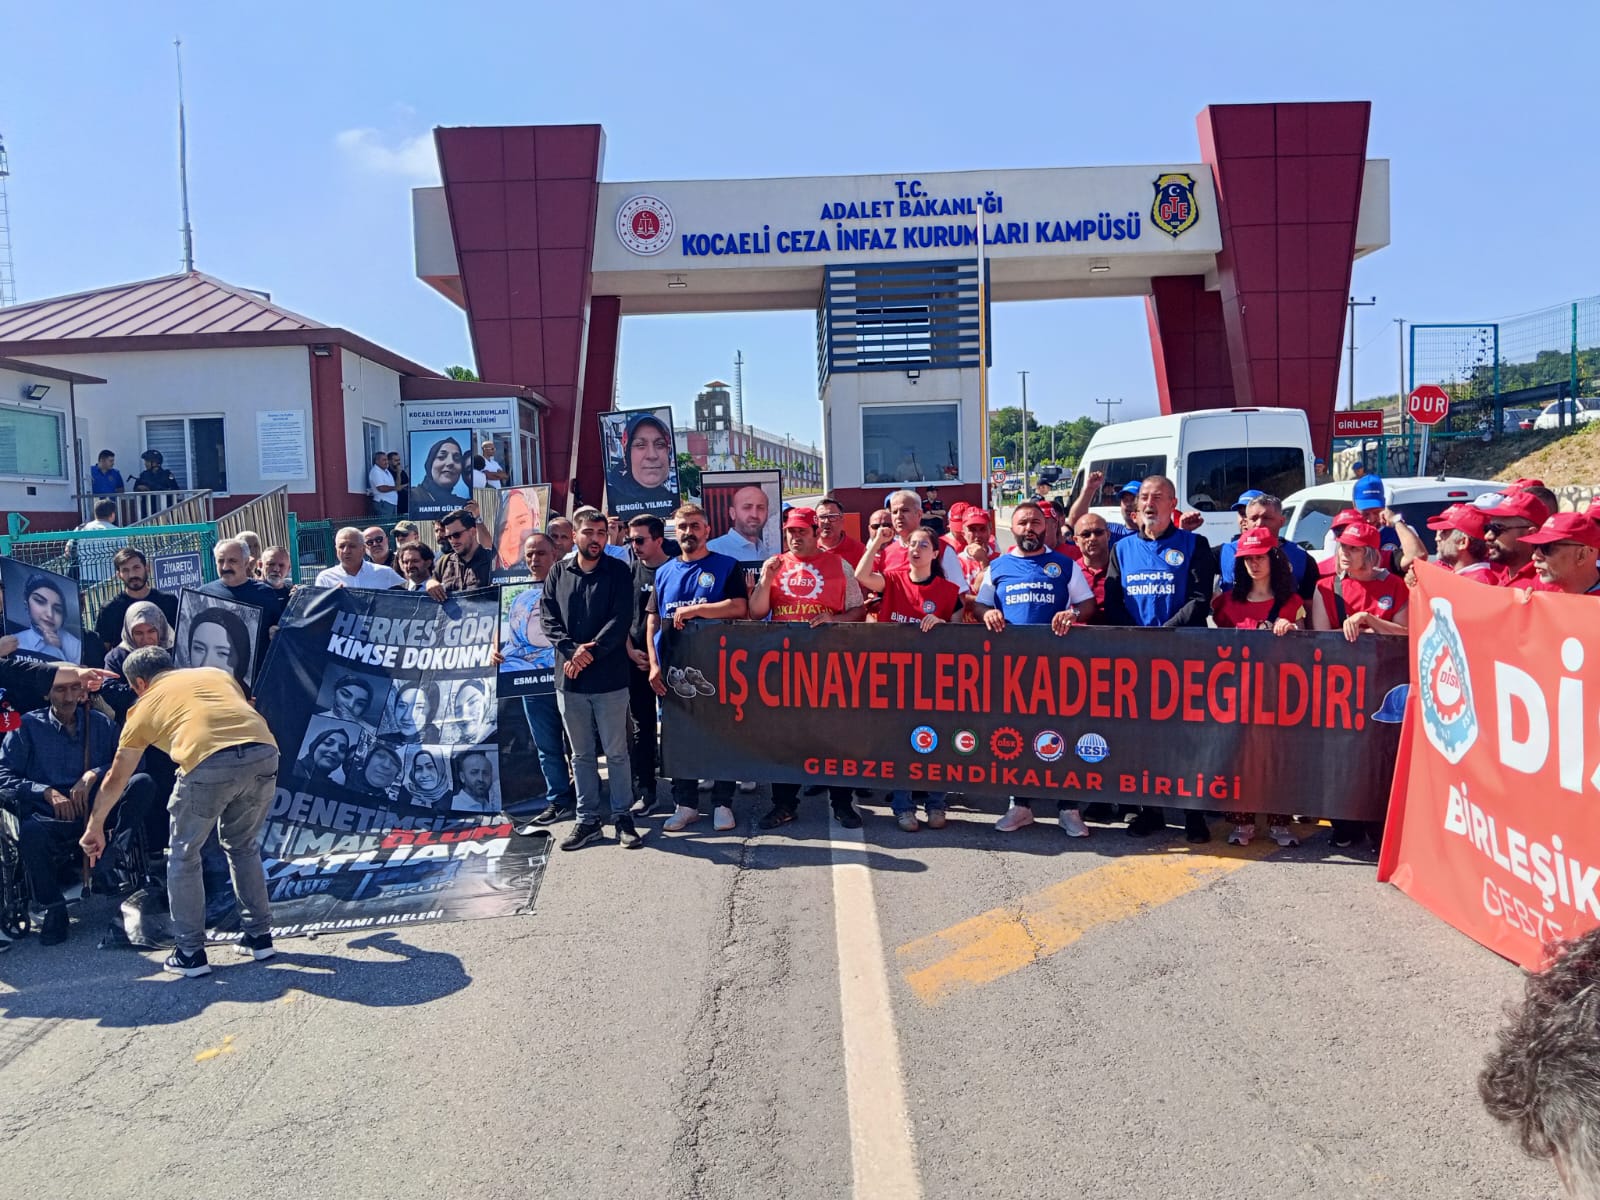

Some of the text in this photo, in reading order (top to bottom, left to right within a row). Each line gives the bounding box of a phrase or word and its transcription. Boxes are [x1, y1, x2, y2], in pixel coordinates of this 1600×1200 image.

[895, 180, 927, 198] T.C.
[820, 200, 895, 220] ADALET
[682, 212, 1141, 256] KOCAELİ CEZA İNFAZ KURUMLARI KAMPÜSÜ
[453, 409, 471, 417] İNFAZ
[1410, 396, 1446, 413] DUR
[422, 417, 454, 425] ZİYARETÇİ
[1338, 419, 1379, 430] GİRİLMEZ
[615, 500, 673, 513] ŞENGÜL YILMAZ
[163, 558, 193, 574] ZİYARETÇİ
[159, 570, 199, 588] KABUL BİRİMİ
[1005, 591, 1055, 605] SENDİKASI
[1126, 582, 1175, 596] SENDİKASI
[331, 610, 439, 647] HERKES
[327, 634, 399, 668] KİMSE
[514, 673, 555, 686] ESMA GİK
[718, 635, 1367, 731] İŞ CİNAYETLERİ KADER DEĞİLDİR!
[1494, 637, 1600, 794] Dİ
[803, 757, 1241, 801] GEBZE SENDİKALAR BİRLİĞİ
[1444, 782, 1600, 921] BİRLEŞİK
[301, 917, 372, 932] KATLİAMI
[376, 910, 443, 925] AİLELERİ
